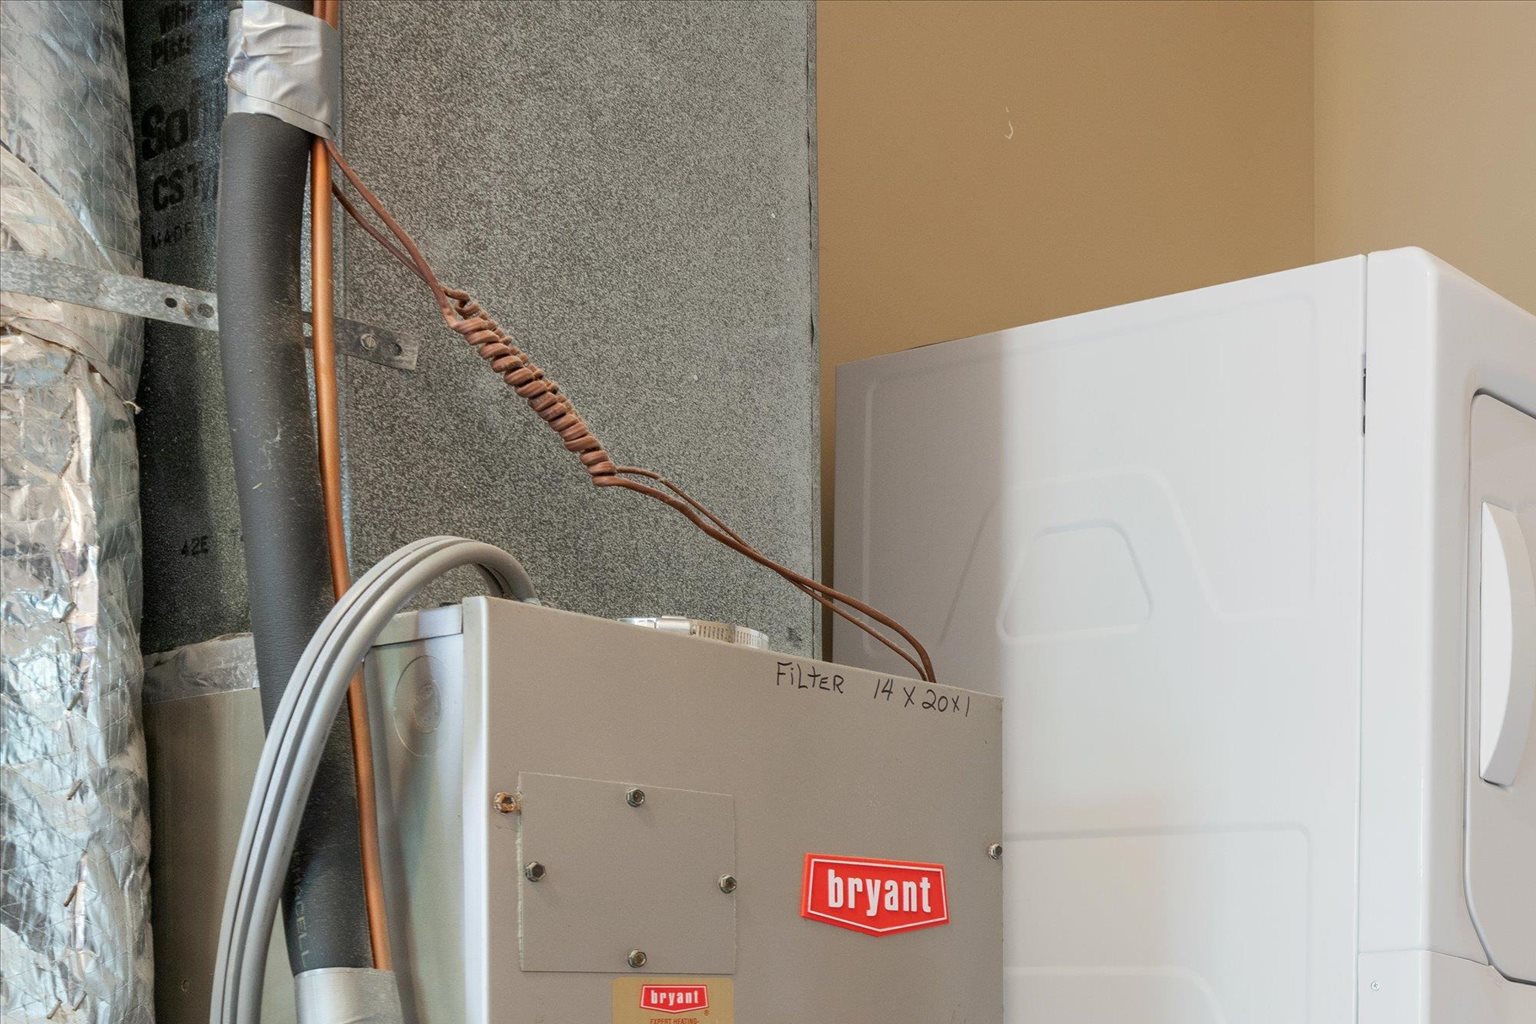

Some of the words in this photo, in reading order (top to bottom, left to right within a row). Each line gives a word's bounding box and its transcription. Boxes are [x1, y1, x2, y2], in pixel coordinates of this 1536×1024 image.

[873, 679, 894, 700] 14
[827, 868, 932, 916] bryant
[650, 989, 699, 1007] bryant
